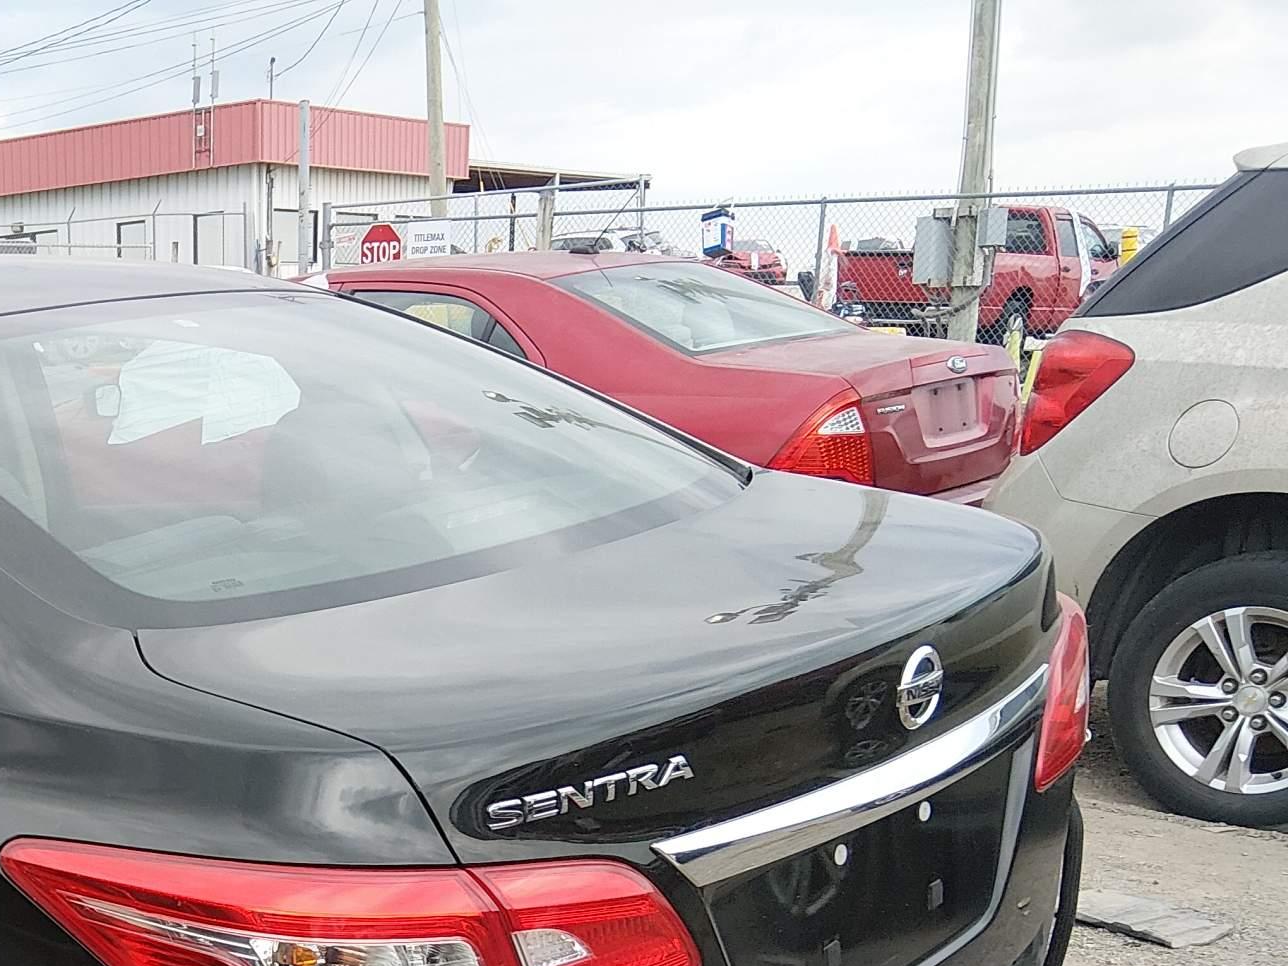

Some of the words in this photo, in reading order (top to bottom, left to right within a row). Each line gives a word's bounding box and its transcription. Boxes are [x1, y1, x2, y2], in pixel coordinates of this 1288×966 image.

[362, 241, 400, 264] STOP
[412, 247, 428, 255] DROP
[430, 246, 447, 254] ZONE
[486, 755, 696, 831] SENTRA
